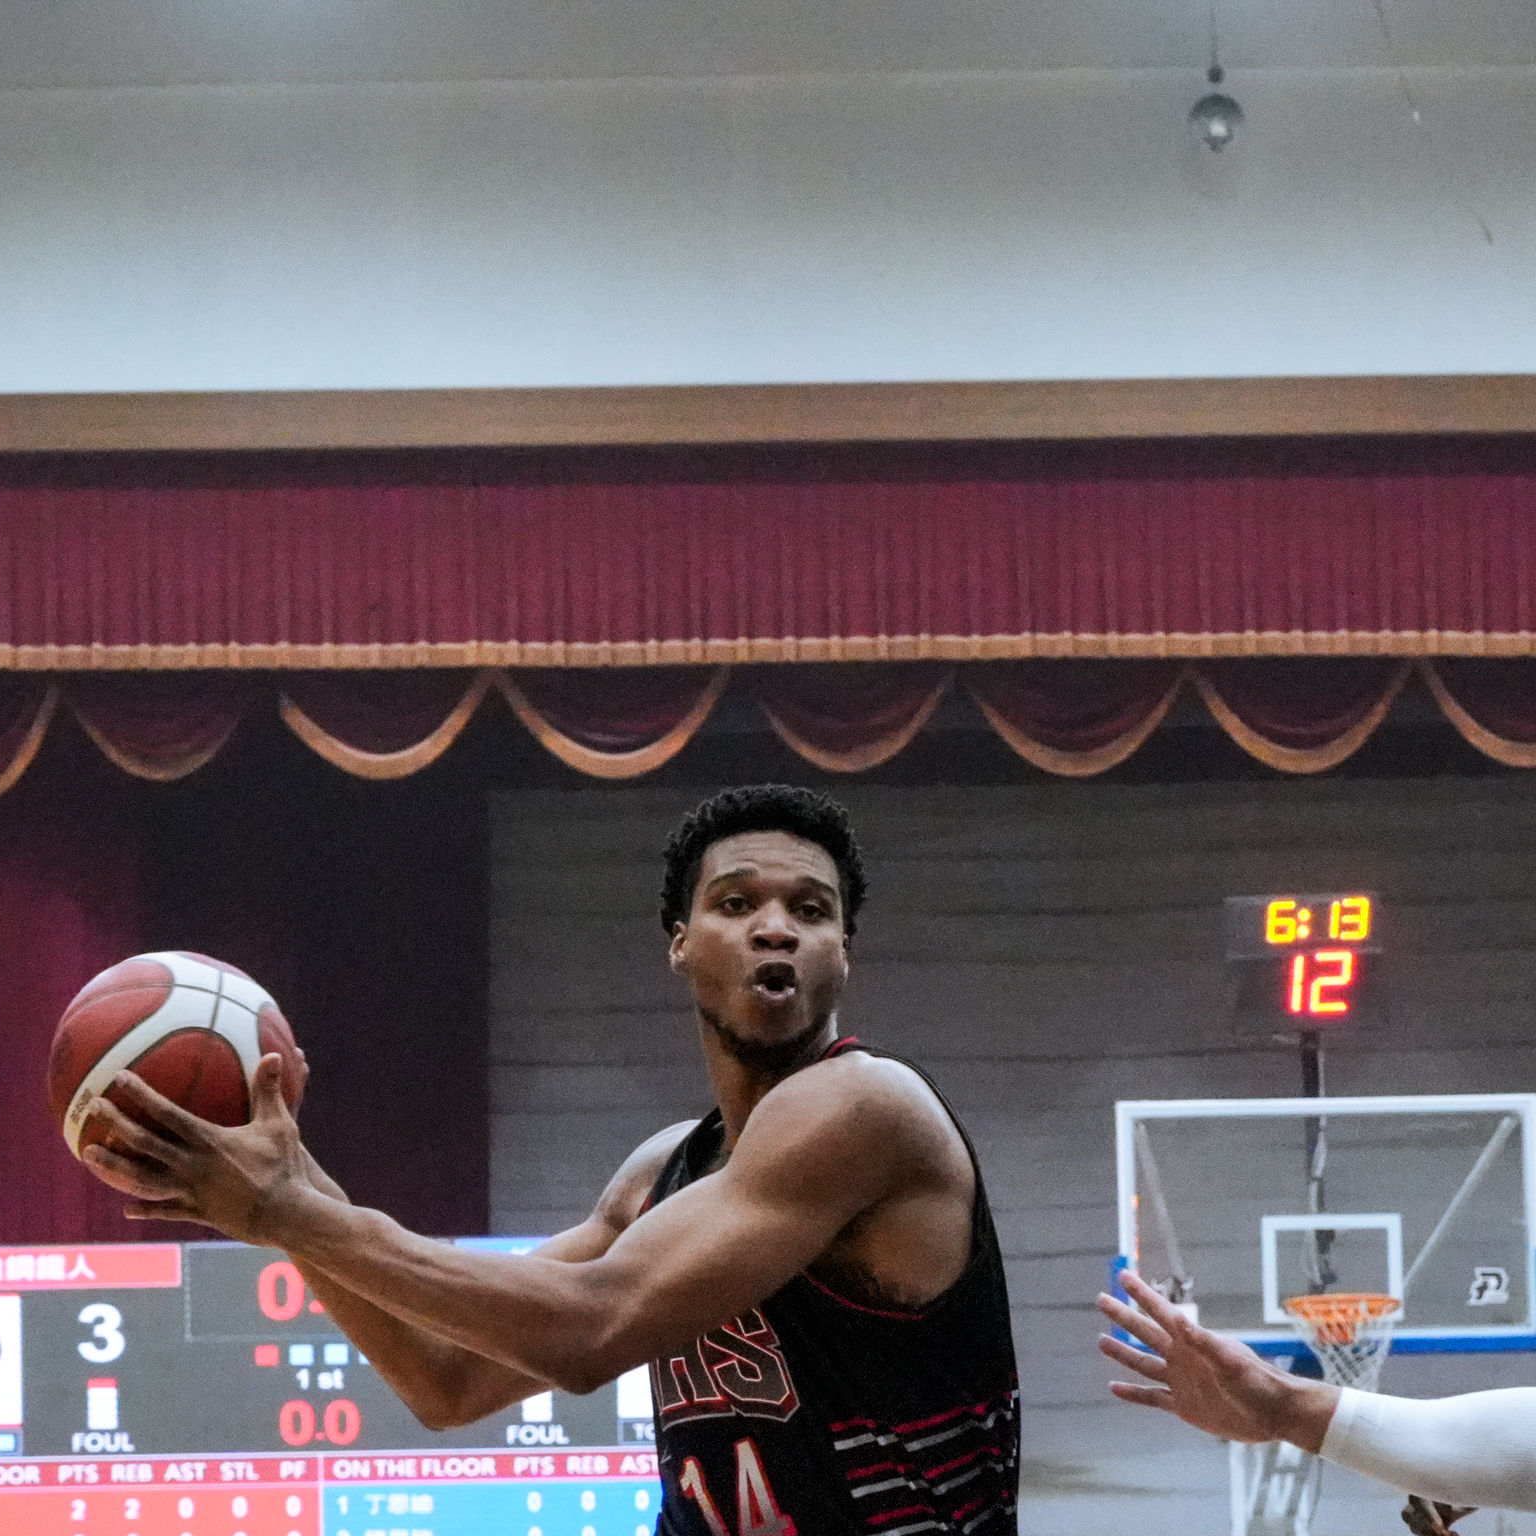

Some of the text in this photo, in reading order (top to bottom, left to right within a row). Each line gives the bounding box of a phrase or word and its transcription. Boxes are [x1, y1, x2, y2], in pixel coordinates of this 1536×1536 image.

[1266, 897, 1370, 944] 6:13
[1289, 951, 1353, 1013] 12
[77, 1303, 126, 1364] 3
[279, 1399, 361, 1446] 0.0
[506, 1424, 570, 1445] FOUL
[71, 1432, 135, 1453] FOUL
[57, 1463, 99, 1484] PTS
[111, 1463, 153, 1483] REB
[163, 1462, 207, 1482] AST
[217, 1461, 258, 1482] STL
[279, 1459, 306, 1479] PF
[332, 1459, 371, 1479] ON
[374, 1458, 417, 1478] THE
[421, 1457, 496, 1477] FLOOR
[513, 1455, 555, 1476] PTS
[566, 1455, 610, 1475] REB
[70, 1499, 86, 1521] 2
[125, 1498, 140, 1520] 2
[178, 1497, 194, 1519] 0
[232, 1496, 248, 1518] 0
[285, 1495, 302, 1517] 0
[337, 1495, 349, 1515] 1
[526, 1491, 542, 1513] 0
[581, 1490, 596, 1512] 0
[635, 1489, 650, 1511] 0
